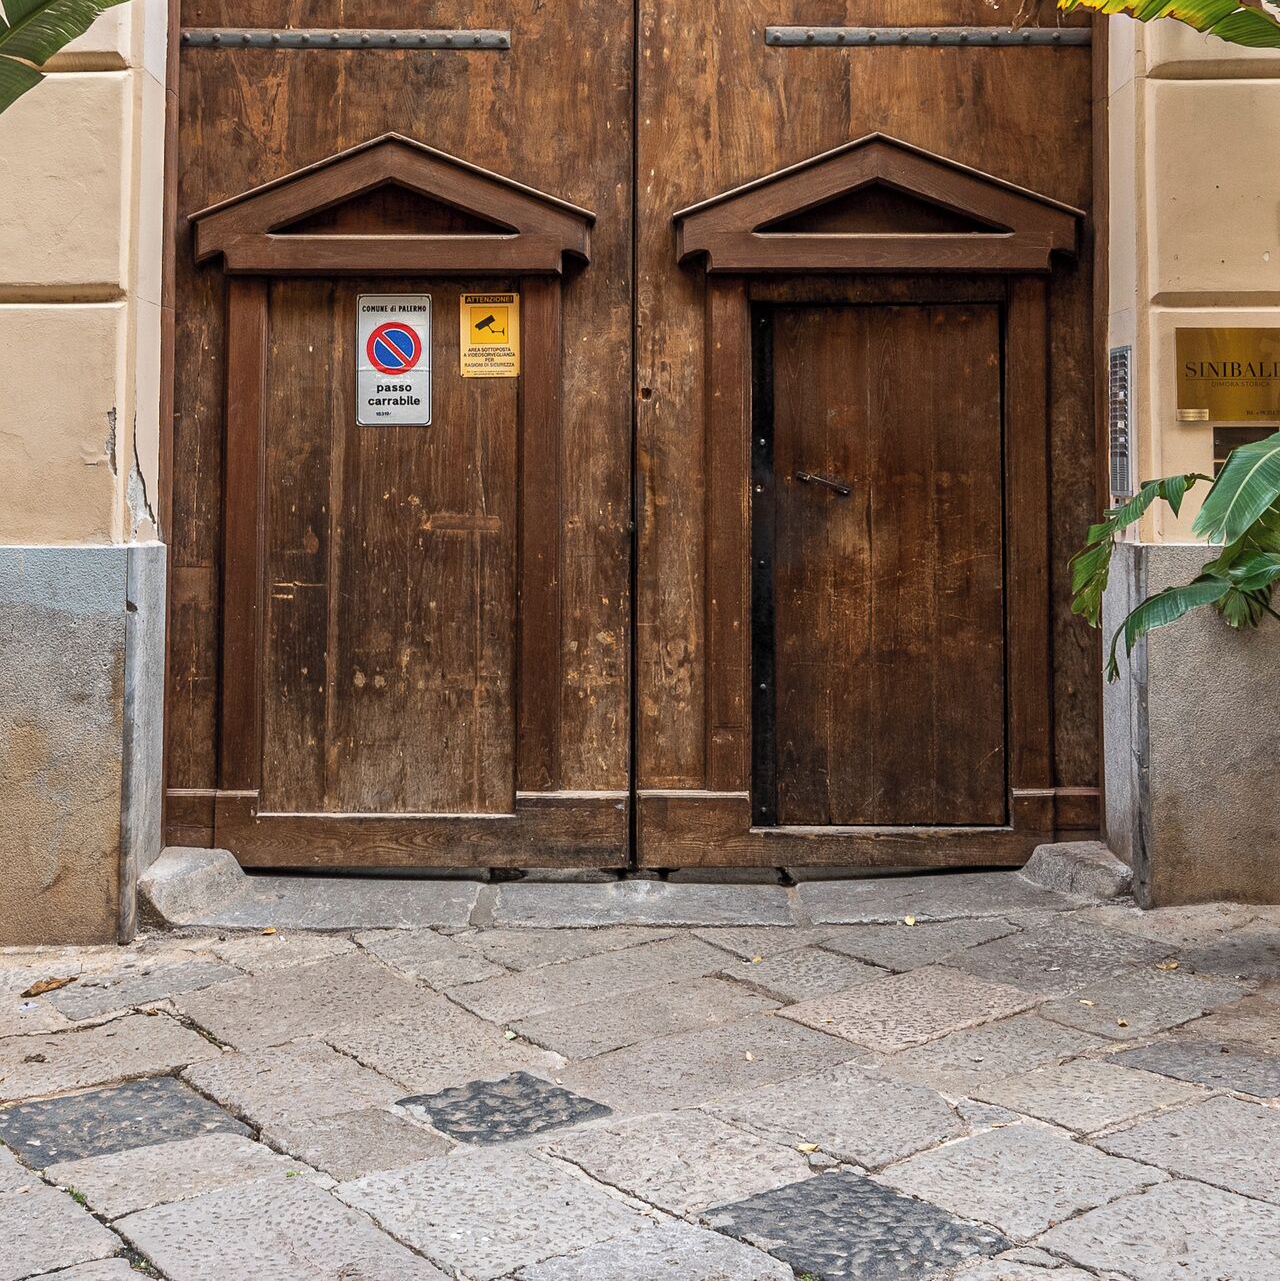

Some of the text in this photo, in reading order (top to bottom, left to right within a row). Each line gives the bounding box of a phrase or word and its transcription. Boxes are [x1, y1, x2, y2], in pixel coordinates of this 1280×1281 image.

[362, 305, 427, 313] COMUNE di PALERMO
[376, 384, 412, 394] passo
[367, 396, 421, 406] carrabile
